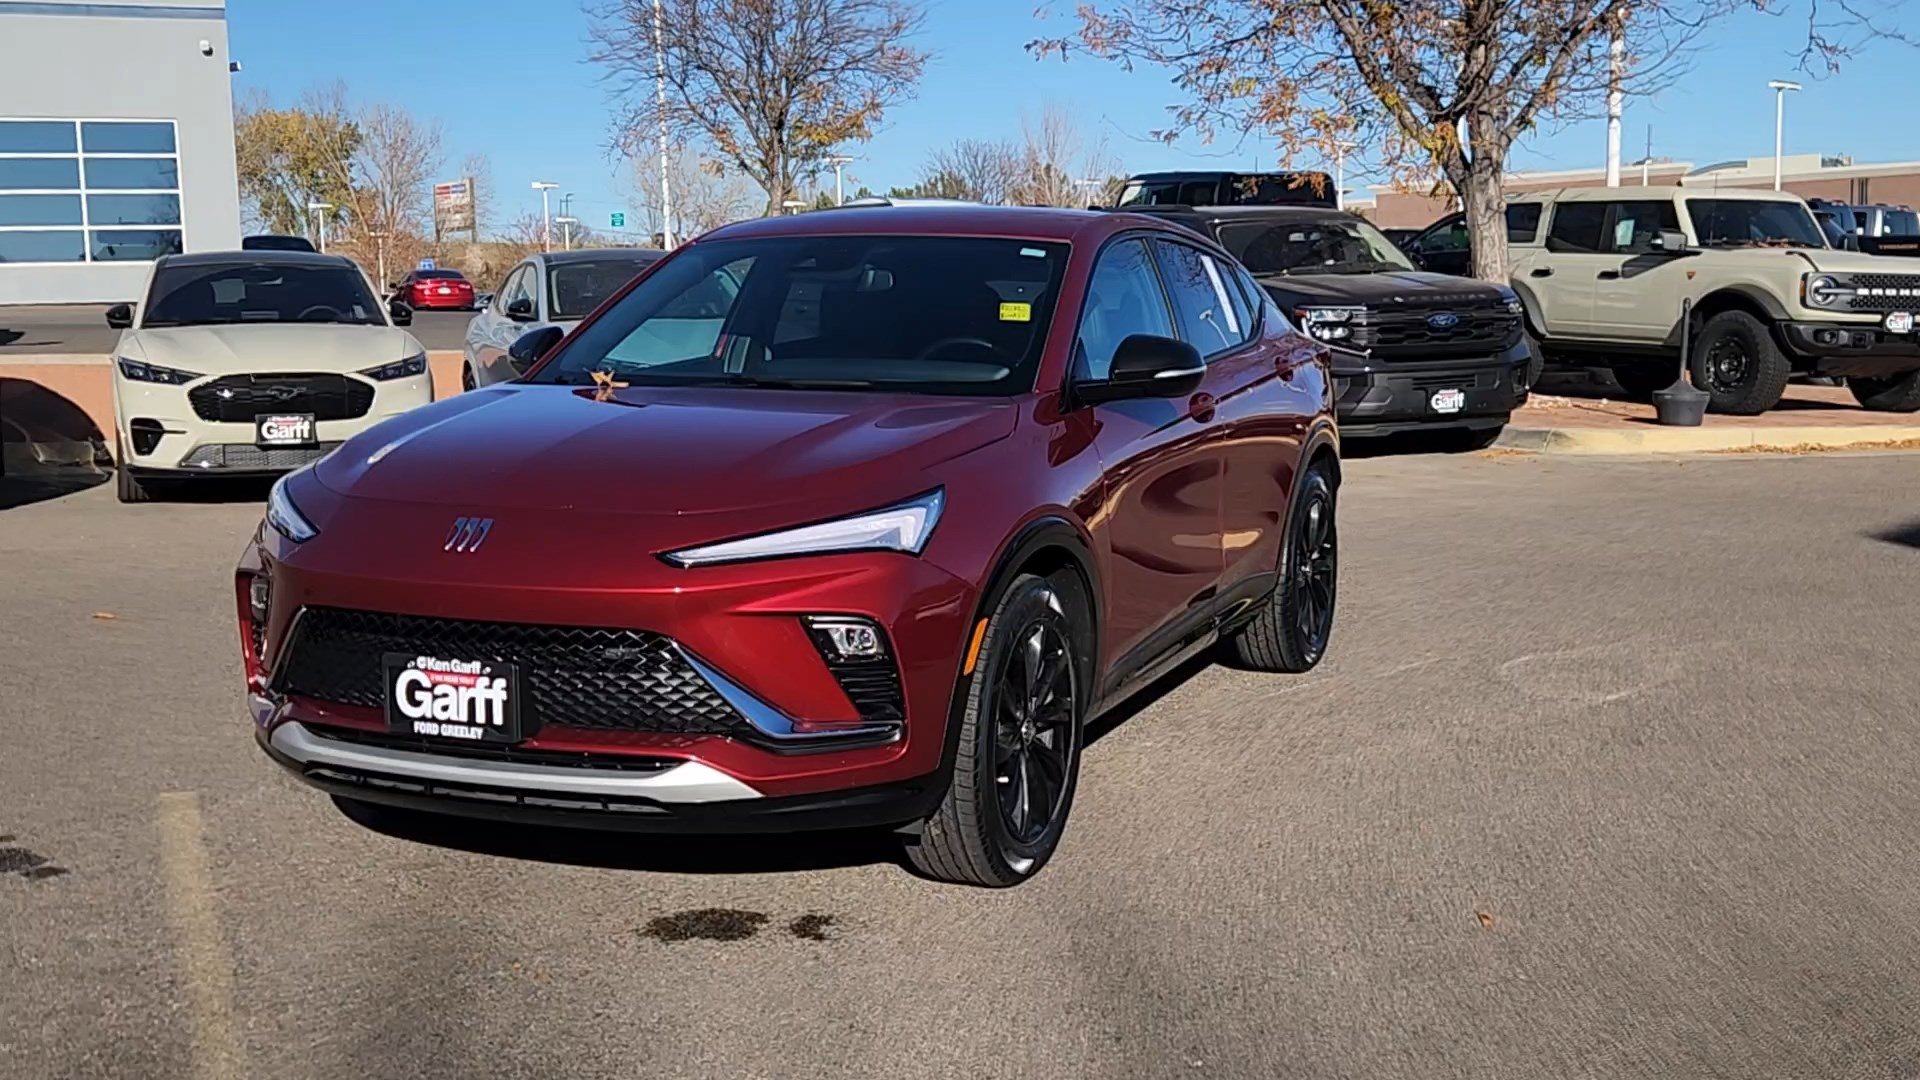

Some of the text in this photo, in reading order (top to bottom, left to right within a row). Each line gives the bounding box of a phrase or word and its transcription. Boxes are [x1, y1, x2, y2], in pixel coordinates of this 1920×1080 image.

[261, 420, 310, 439] Garff
[427, 656, 482, 674] Ken Garff
[395, 669, 508, 726] Garff
[413, 721, 484, 740] FORD GREELEY
